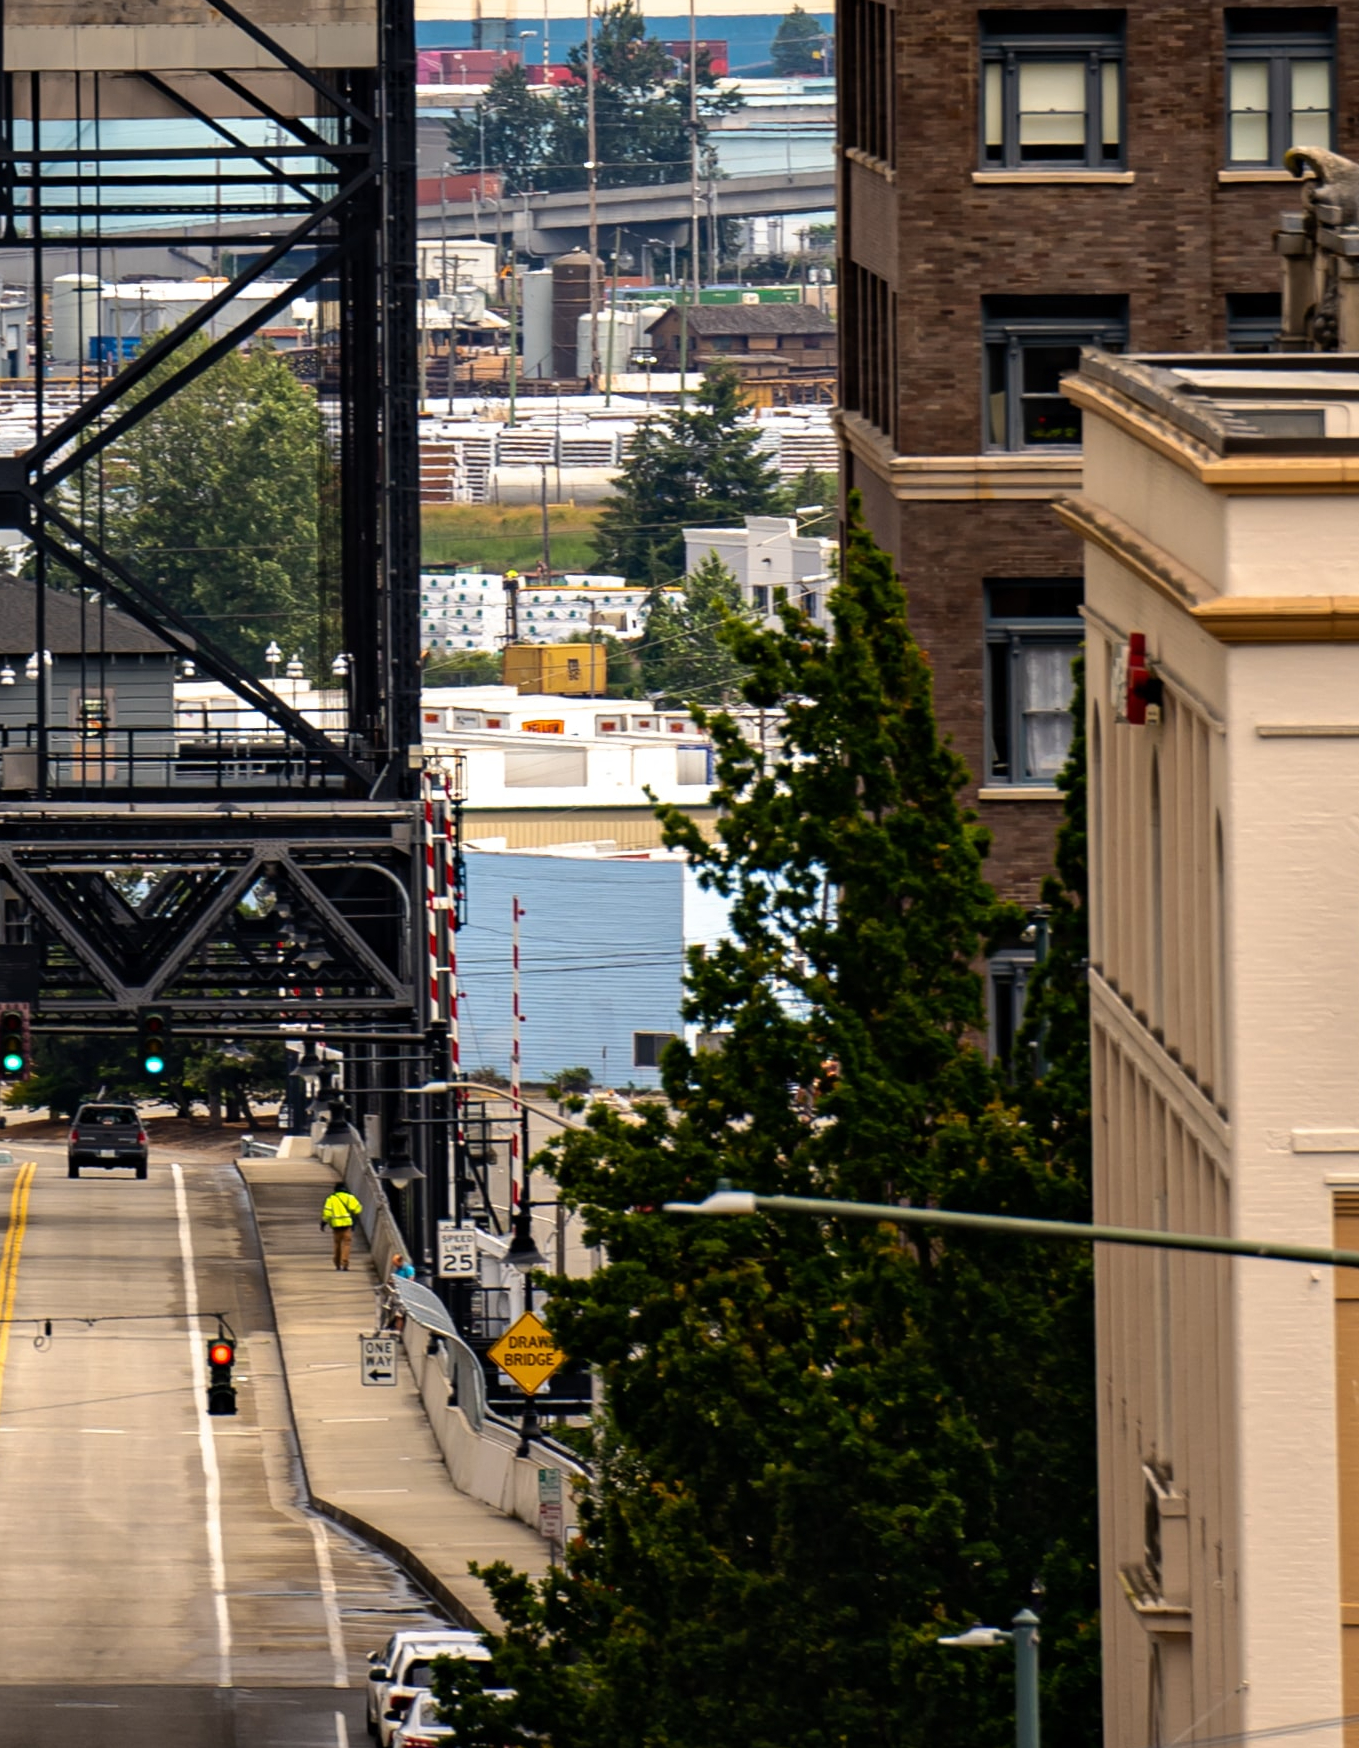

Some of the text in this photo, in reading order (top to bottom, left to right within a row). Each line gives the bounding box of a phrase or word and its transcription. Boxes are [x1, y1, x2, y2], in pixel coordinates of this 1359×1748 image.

[442, 1235, 473, 1243] SPEED
[444, 1245, 470, 1253] LIMIT
[443, 1255, 473, 1271] 25
[365, 1342, 392, 1354] ONE
[366, 1355, 392, 1367] WAY
[504, 1353, 555, 1366] BRIDGE
